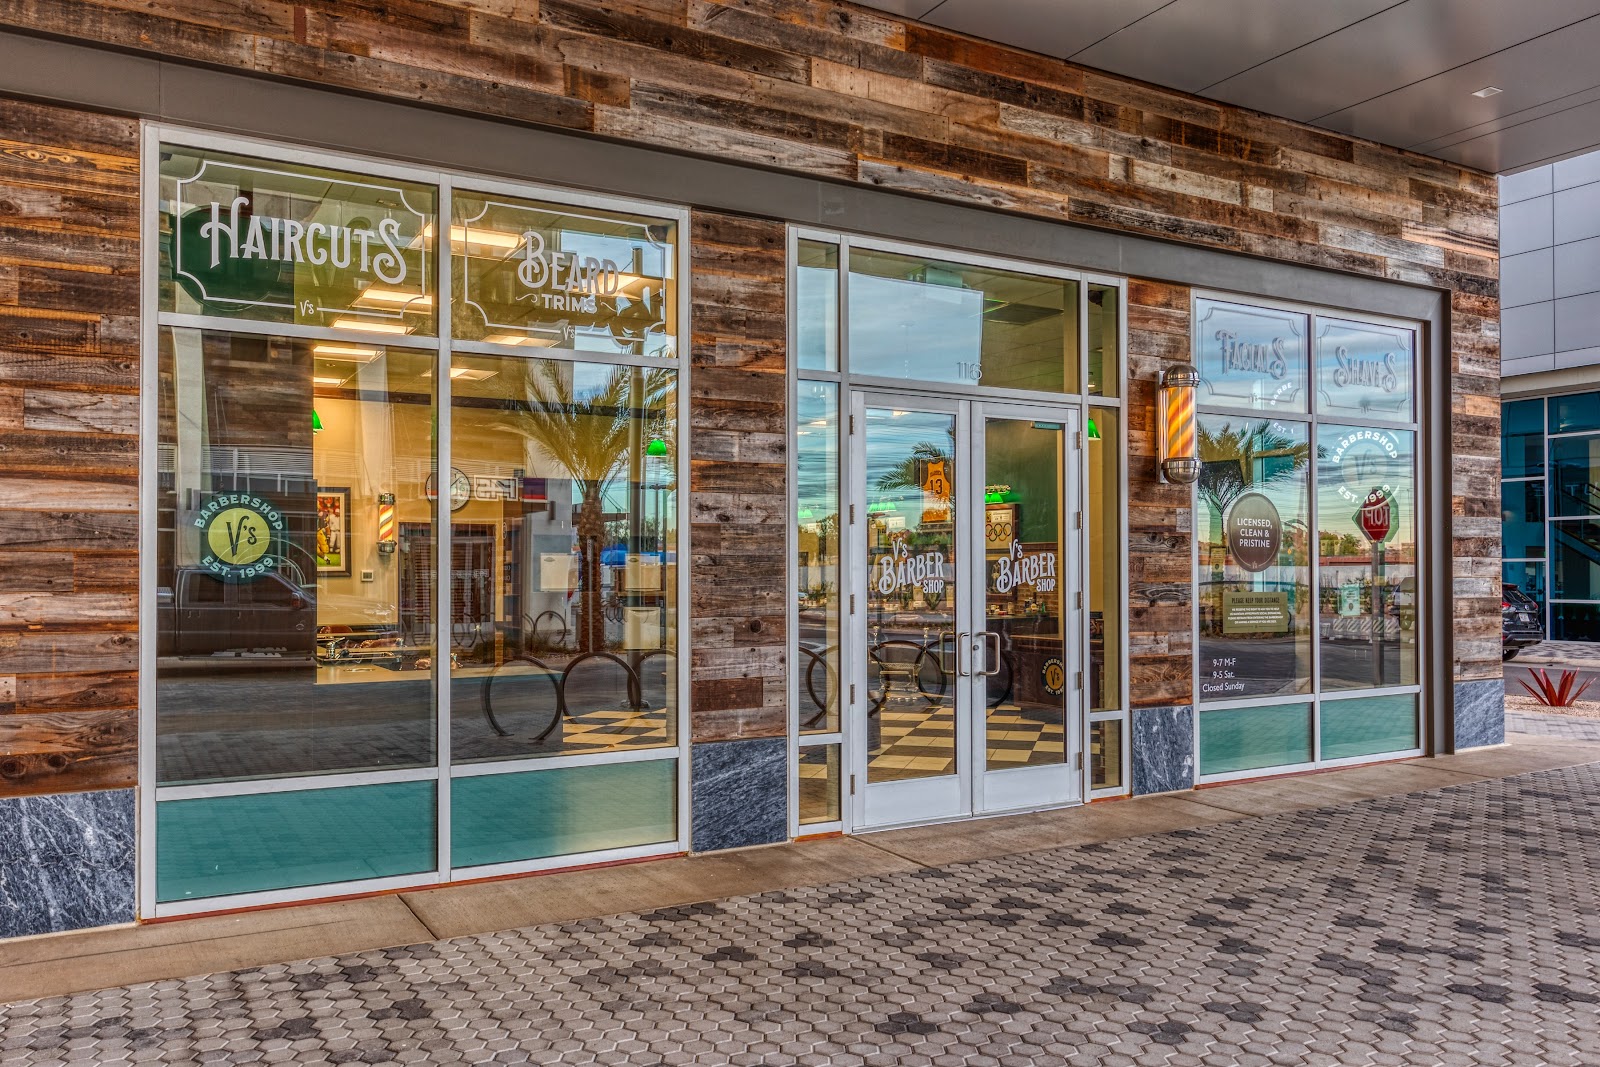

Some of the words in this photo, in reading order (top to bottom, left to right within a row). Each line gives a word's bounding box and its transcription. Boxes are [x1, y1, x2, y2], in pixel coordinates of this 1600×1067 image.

[200, 196, 407, 284] HAIRCUTS
[518, 231, 619, 295] BEARD
[541, 293, 598, 314] TRIMS
[1215, 329, 1287, 380] FACIALS
[1334, 346, 1397, 393] SHAVES
[1332, 430, 1398, 463] BARBERSHOP
[930, 478, 943, 495] 13
[1338, 485, 1359, 504] EST.
[1364, 484, 1391, 504] 1999
[194, 494, 284, 529] BARBERSHOP
[1237, 517, 1273, 529] LICENSED,
[1240, 529, 1263, 537] CLEAN
[1264, 530, 1270, 538] &
[226, 515, 258, 557] V's
[1239, 539, 1271, 548] PRISTINE
[892, 538, 908, 561] V's
[1009, 539, 1023, 561] V's
[202, 555, 232, 578] EST.
[239, 557, 274, 578] 1999
[879, 552, 944, 594] BARBER
[996, 553, 1056, 593] BARBER
[923, 580, 945, 593] SHOP
[1036, 579, 1056, 592] SHOP
[1212, 658, 1223, 667] 9-7
[1224, 657, 1237, 667] M-F
[1212, 670, 1223, 679] 9-5
[1224, 670, 1235, 679] Sat.
[1202, 683, 1224, 692] Closed
[1224, 681, 1245, 692] Sunday
